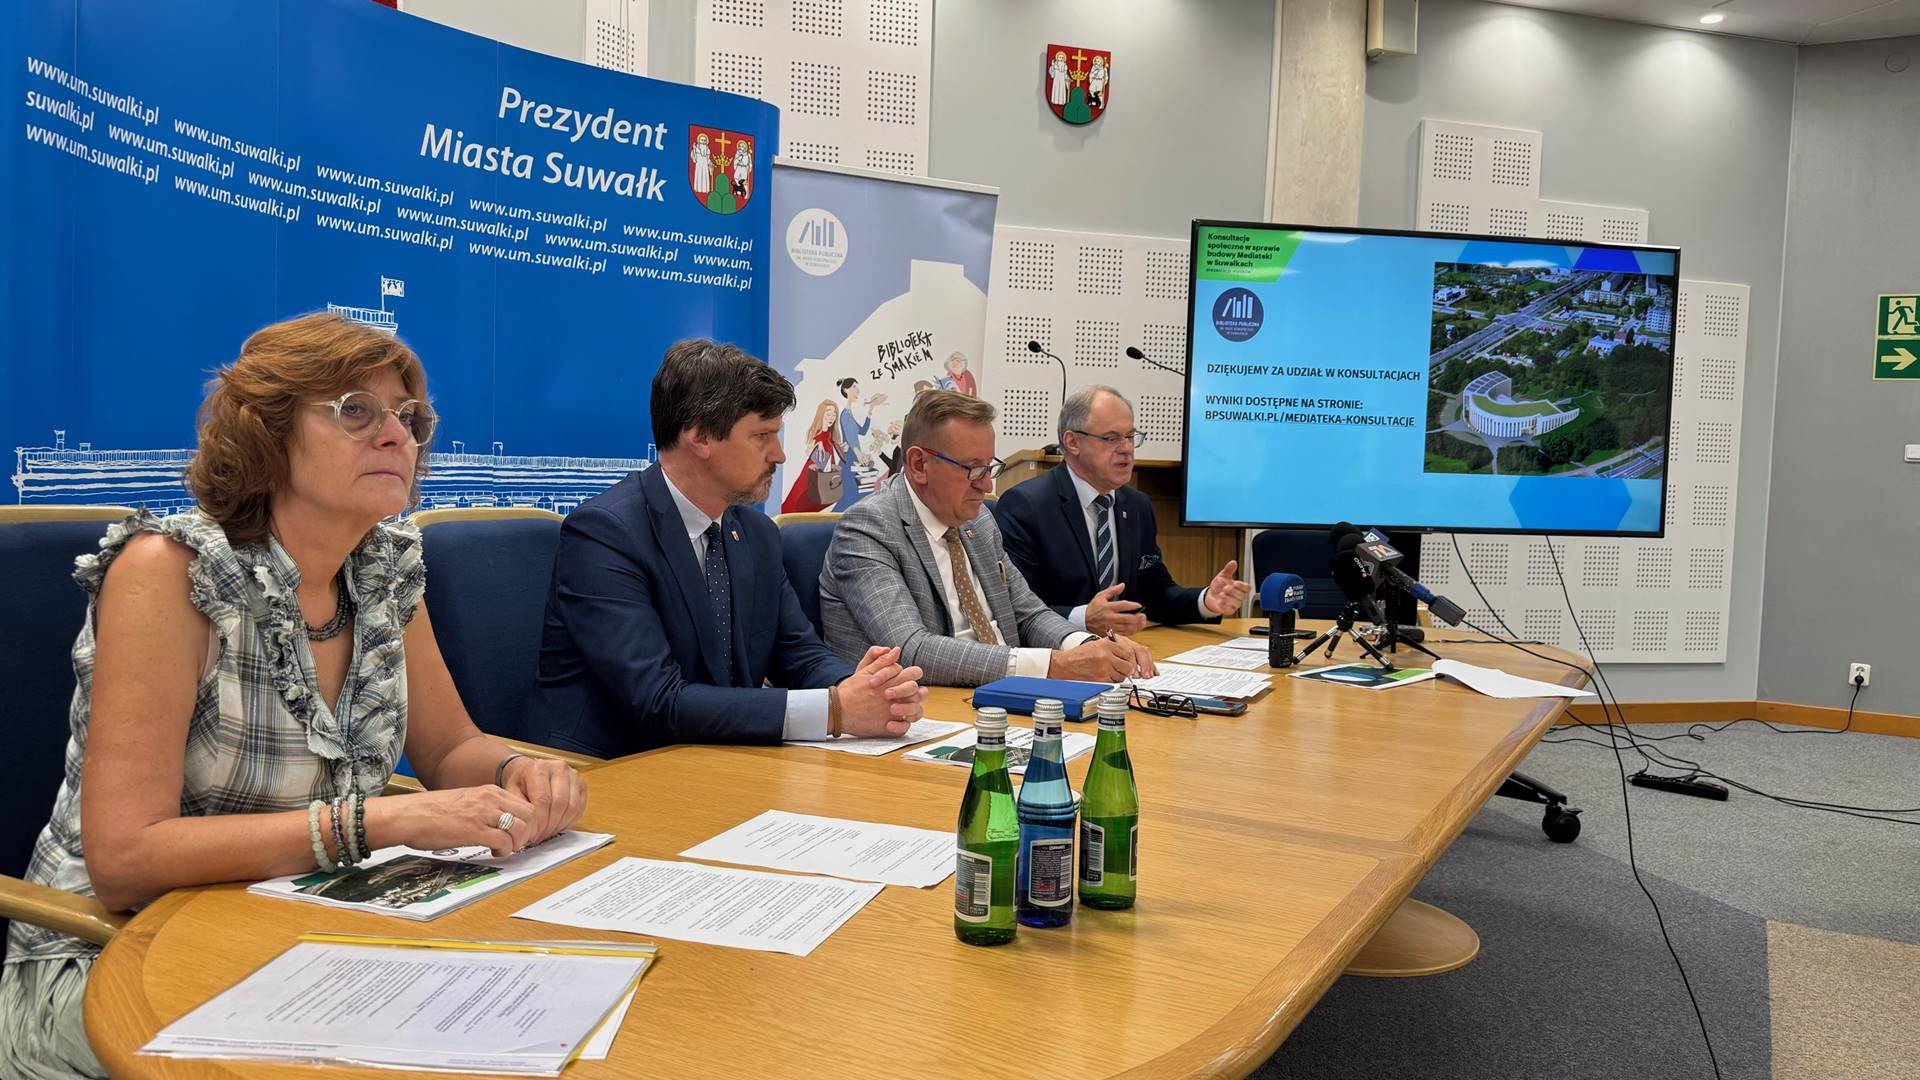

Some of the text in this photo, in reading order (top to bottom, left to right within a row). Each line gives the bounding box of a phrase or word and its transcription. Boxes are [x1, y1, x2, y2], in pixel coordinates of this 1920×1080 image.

[498, 86, 668, 151] Prezydent
[28, 57, 753, 254] www.um.suwalki.pl www.um.suwalki.pl www.um.suwalki.pl www.um.suwalki.pl www.um.suwalki.pl
[420, 123, 667, 202] Miasta Suwałk
[26, 91, 753, 271] suwalki.pl www.um.suwalki.pl www.um.suwalki.pl www.um.suwalki.pl www.um.suwalki.pl www.um.
[27, 124, 753, 291] www.um.suwalki.pl www.um.suwalki.pl www.um.suwalki.pl www.um.suwalki.pl www.um.suwalki.pl
[1206, 250, 1273, 260] budowy Mediateki
[1207, 232, 1250, 243] Konsultacje
[1207, 363, 1421, 381] DZIĘKUJEMY ZA UDZIAŁ W KONSULTACJACH
[1205, 395, 1363, 410] WYNIKI DOSTĘPNE NA STRONIE:
[1205, 410, 1416, 427] BPSUWALKI.PL/MEDIATEKA-KONSULTACJE
